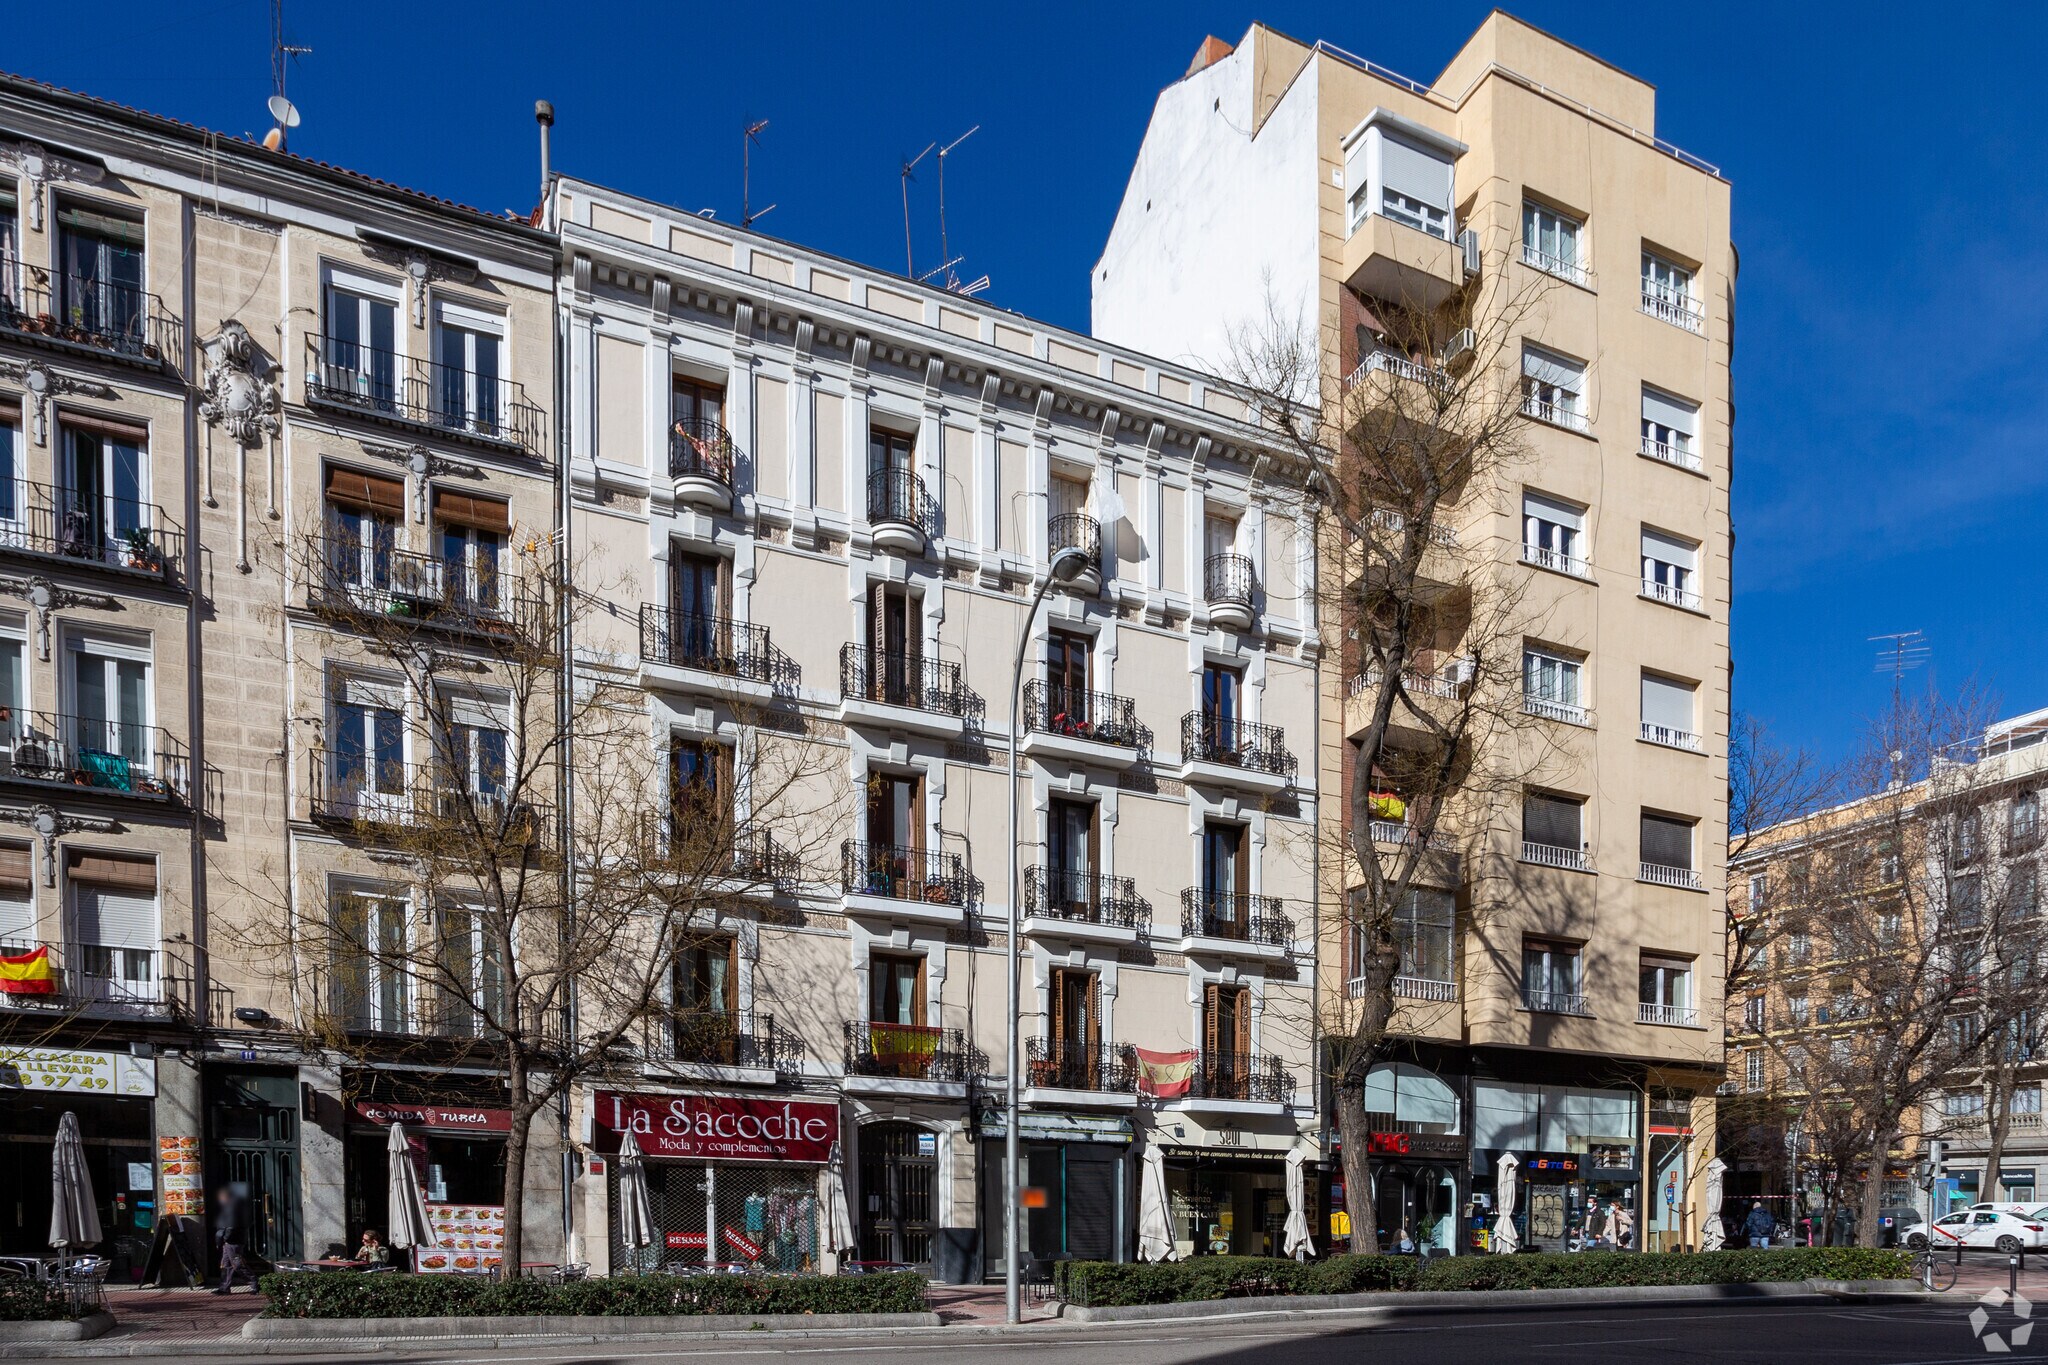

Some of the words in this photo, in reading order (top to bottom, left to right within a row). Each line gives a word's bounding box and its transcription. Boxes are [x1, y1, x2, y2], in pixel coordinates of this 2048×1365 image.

[35, 1053, 107, 1065] CASERA
[244, 1051, 253, 1060] 11
[27, 1062, 93, 1075] LLEVAR
[41, 1074, 71, 1088] 97
[79, 1077, 108, 1090] 49
[246, 1081, 258, 1091] 11
[366, 1108, 424, 1121] COMIDA
[440, 1112, 487, 1124] TURCA
[611, 1097, 653, 1134] La
[663, 1100, 827, 1142] Sacoche
[659, 1138, 690, 1150] Moda
[696, 1141, 703, 1154] y
[708, 1142, 787, 1154] complementos
[725, 1229, 758, 1256] REBAJAS
